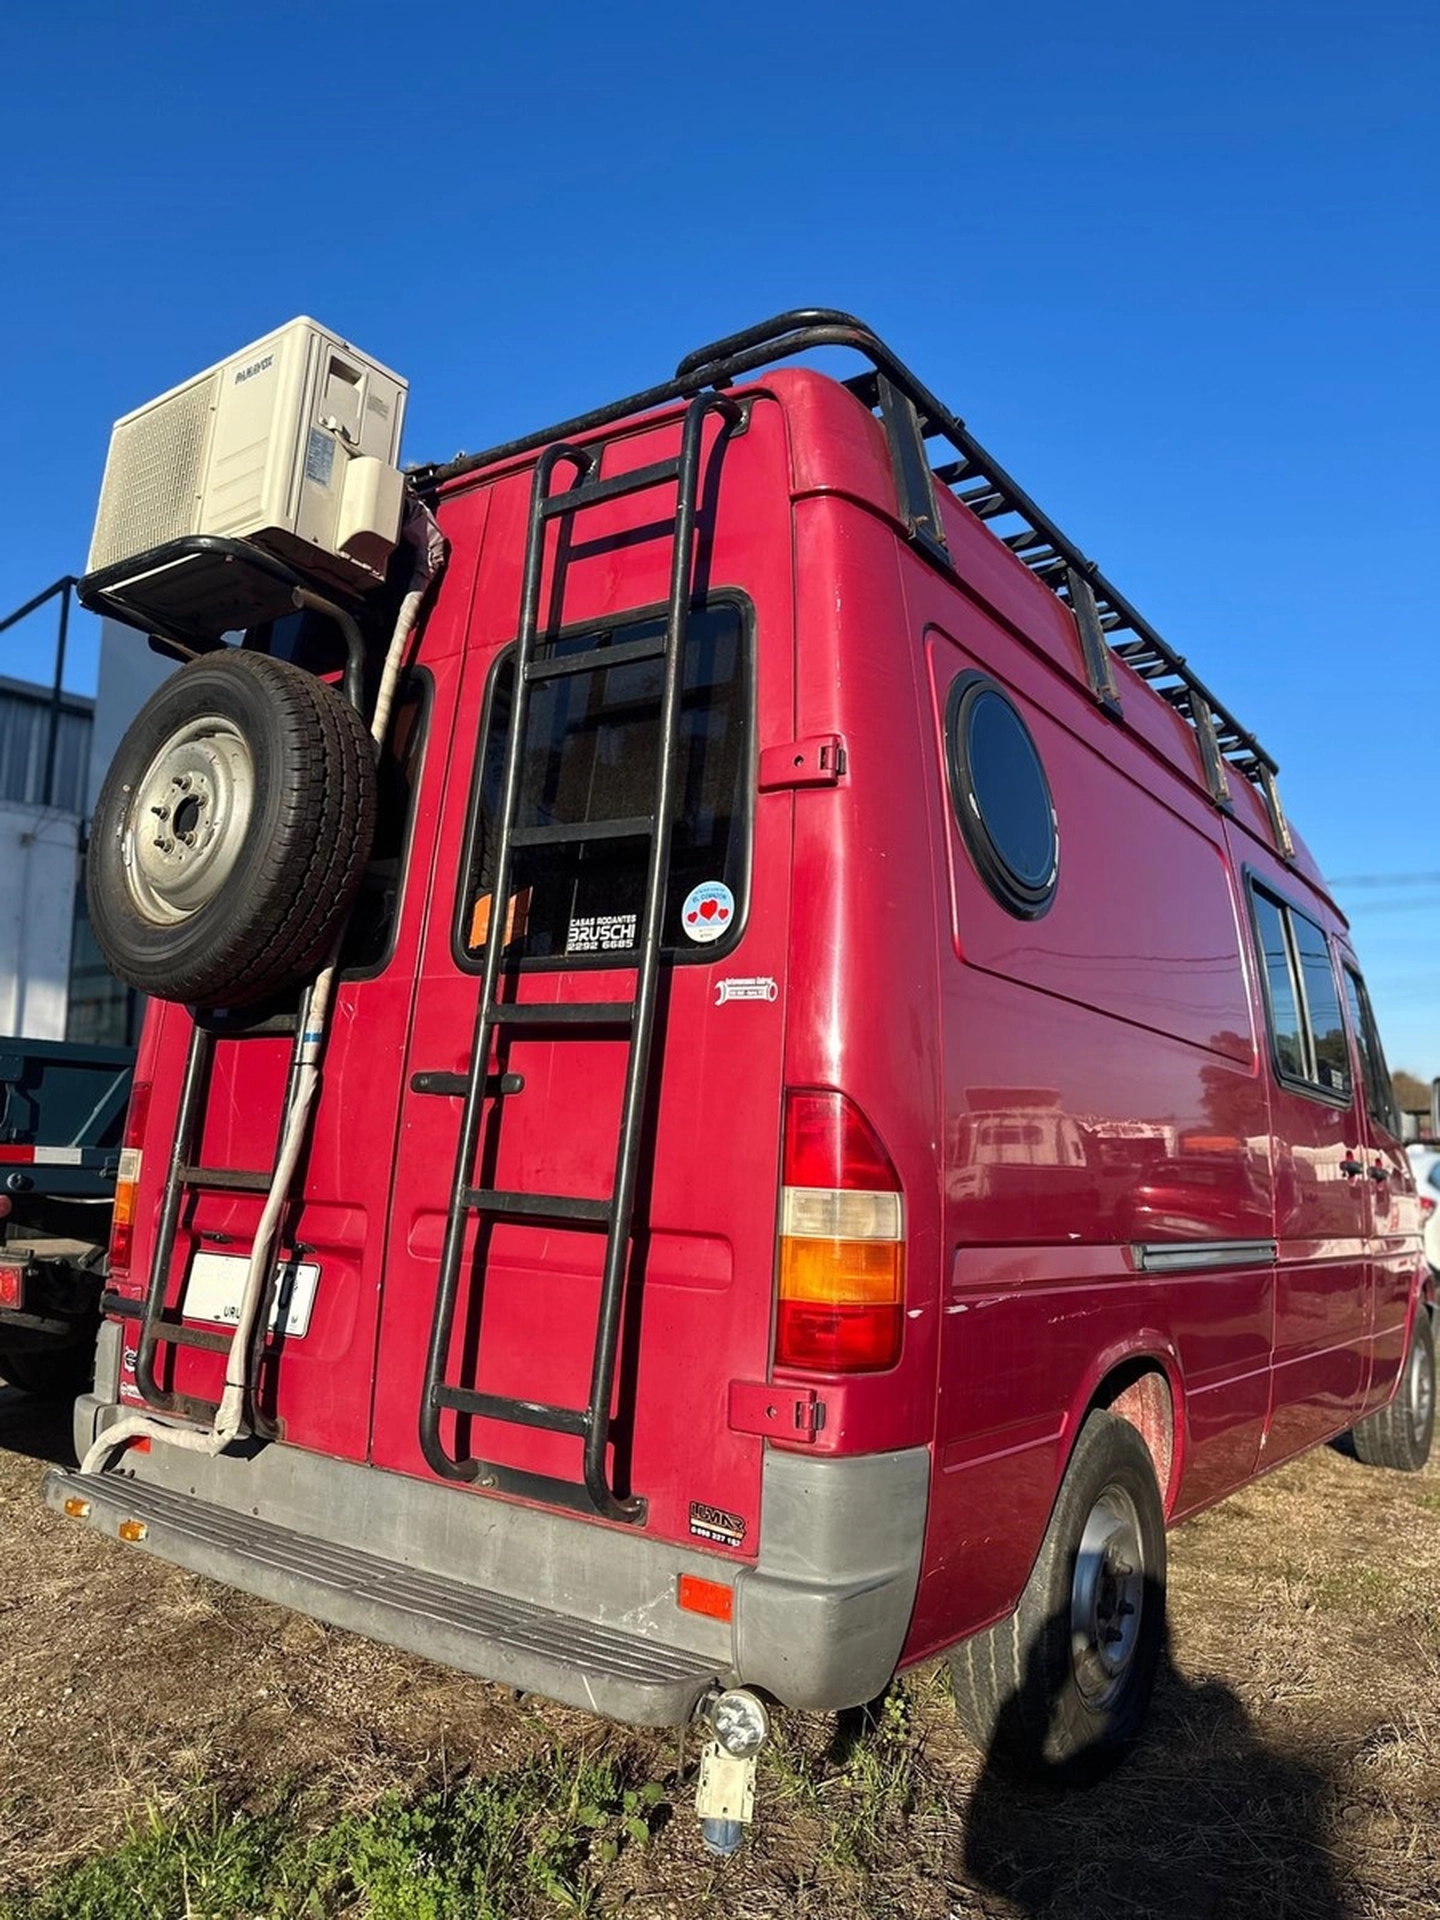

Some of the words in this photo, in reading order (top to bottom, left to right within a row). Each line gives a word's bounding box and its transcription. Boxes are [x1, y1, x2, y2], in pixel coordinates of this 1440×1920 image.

[570, 917, 596, 927] CASAS
[596, 914, 637, 925] RODANTES
[567, 924, 637, 942] BRUSCHI
[566, 941, 599, 951] 2292
[602, 939, 634, 950] 6685
